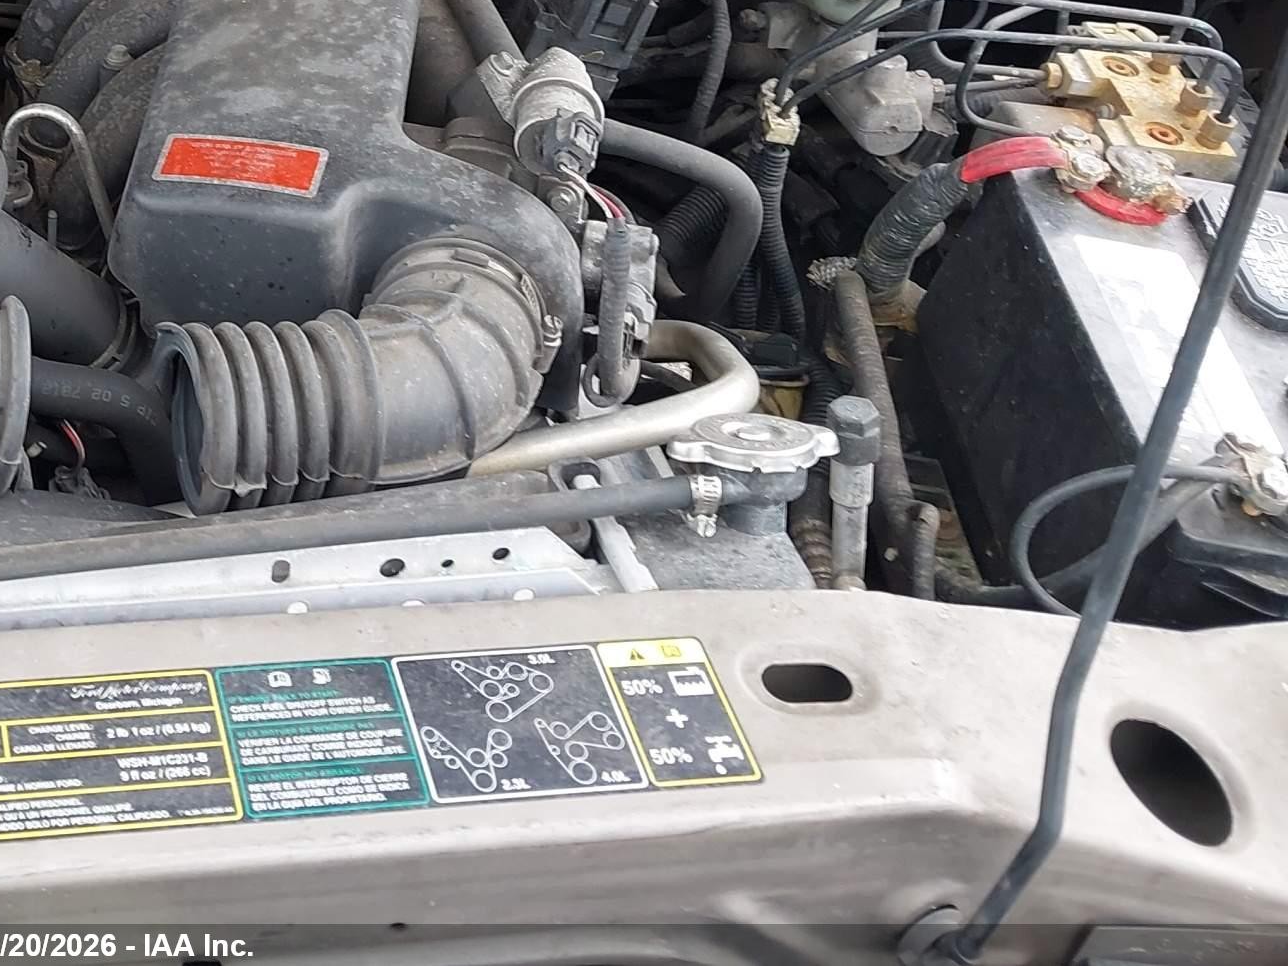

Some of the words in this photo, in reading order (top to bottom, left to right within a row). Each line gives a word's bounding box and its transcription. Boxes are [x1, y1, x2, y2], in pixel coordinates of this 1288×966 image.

[526, 653, 556, 665] 3.0L
[619, 677, 664, 696] 50%
[647, 745, 694, 765] 50%
[599, 769, 632, 783] 4.0L
[500, 777, 531, 790] 2.3L
